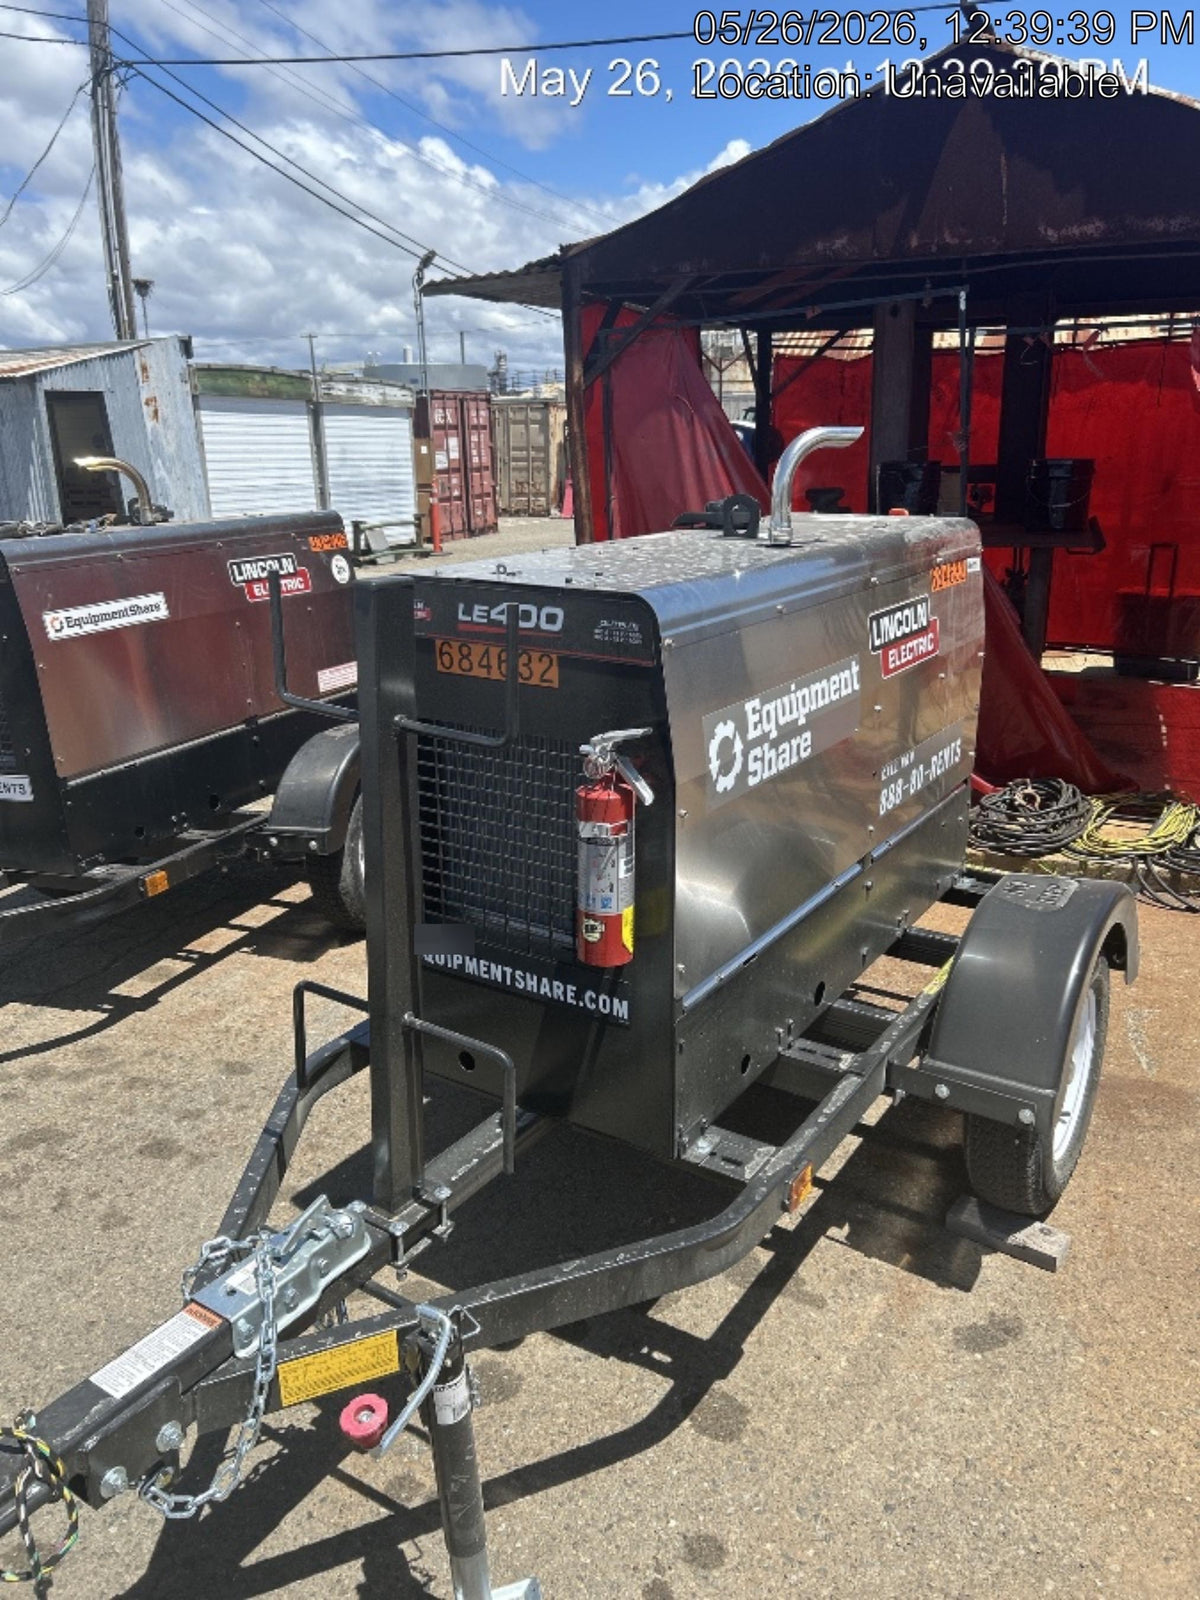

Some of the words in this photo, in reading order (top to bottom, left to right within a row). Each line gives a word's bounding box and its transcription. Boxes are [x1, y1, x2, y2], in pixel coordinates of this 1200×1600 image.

[253, 577, 306, 597] ELTRIC
[458, 602, 564, 632] LE400
[872, 602, 928, 646] LINCOLN
[888, 632, 935, 669] ELECTRIC
[745, 660, 860, 741] Equipment
[748, 731, 812, 786] Share
